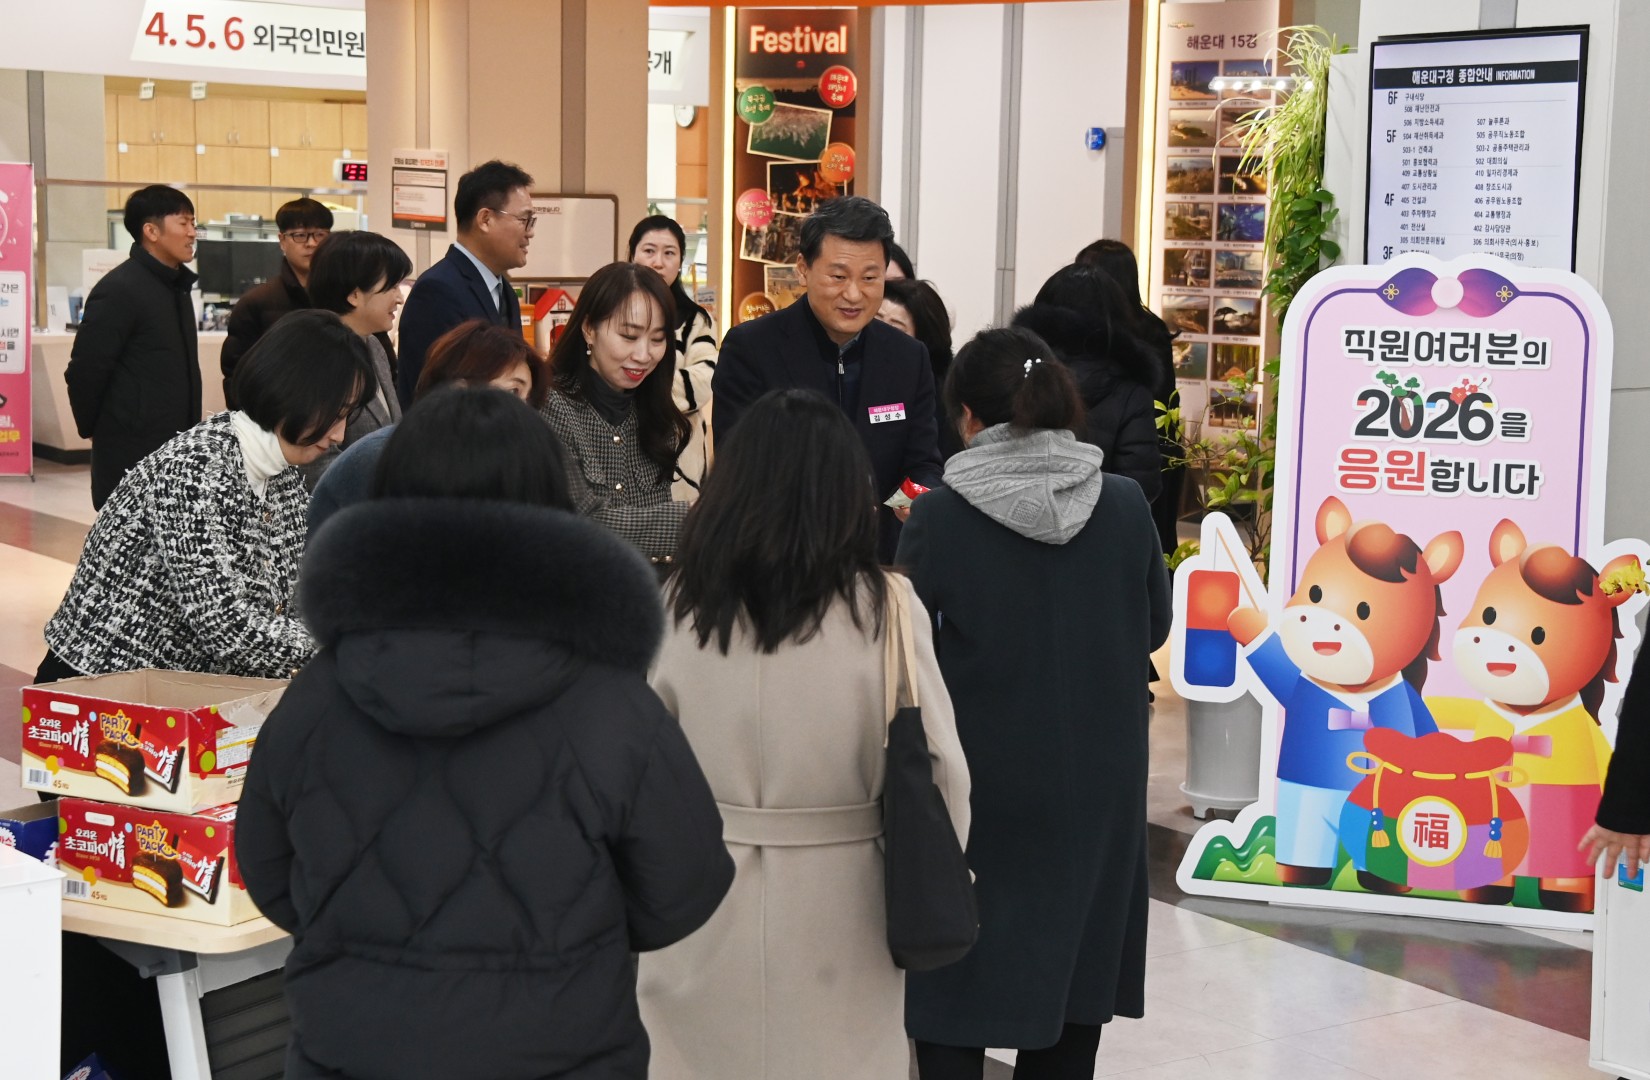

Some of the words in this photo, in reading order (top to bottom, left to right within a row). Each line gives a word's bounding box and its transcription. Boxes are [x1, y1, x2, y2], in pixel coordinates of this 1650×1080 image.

[253, 25, 365, 58] 외국인민원
[749, 25, 847, 54] Festival
[1187, 35, 1224, 50] 해운대
[1231, 34, 1257, 49] 15경
[1412, 70, 1454, 85] 해운대구청
[1459, 67, 1493, 83] 종합안내
[1496, 69, 1536, 81] INFORMATION
[1387, 91, 1398, 105] 6F
[1405, 93, 1425, 101] 구내식당
[1386, 130, 1396, 143] 5F
[1418, 146, 1433, 154] 건축과
[1412, 182, 1438, 191] 도시관리과
[1384, 193, 1395, 206] 4F
[1411, 196, 1427, 204] 건설과
[1383, 245, 1393, 260] 3F
[1345, 330, 1547, 366] 직원여러분의
[1338, 448, 1540, 496] 응원합니다
[39, 717, 62, 729] 오리온
[101, 714, 129, 731] PARTY
[28, 726, 73, 746] 초코파이
[104, 726, 128, 743] PACK
[75, 828, 98, 840] 오리온
[136, 825, 166, 842] PARTY
[1413, 812, 1450, 851] 福
[65, 836, 109, 857] 초코파이
[140, 837, 165, 853] PACK
